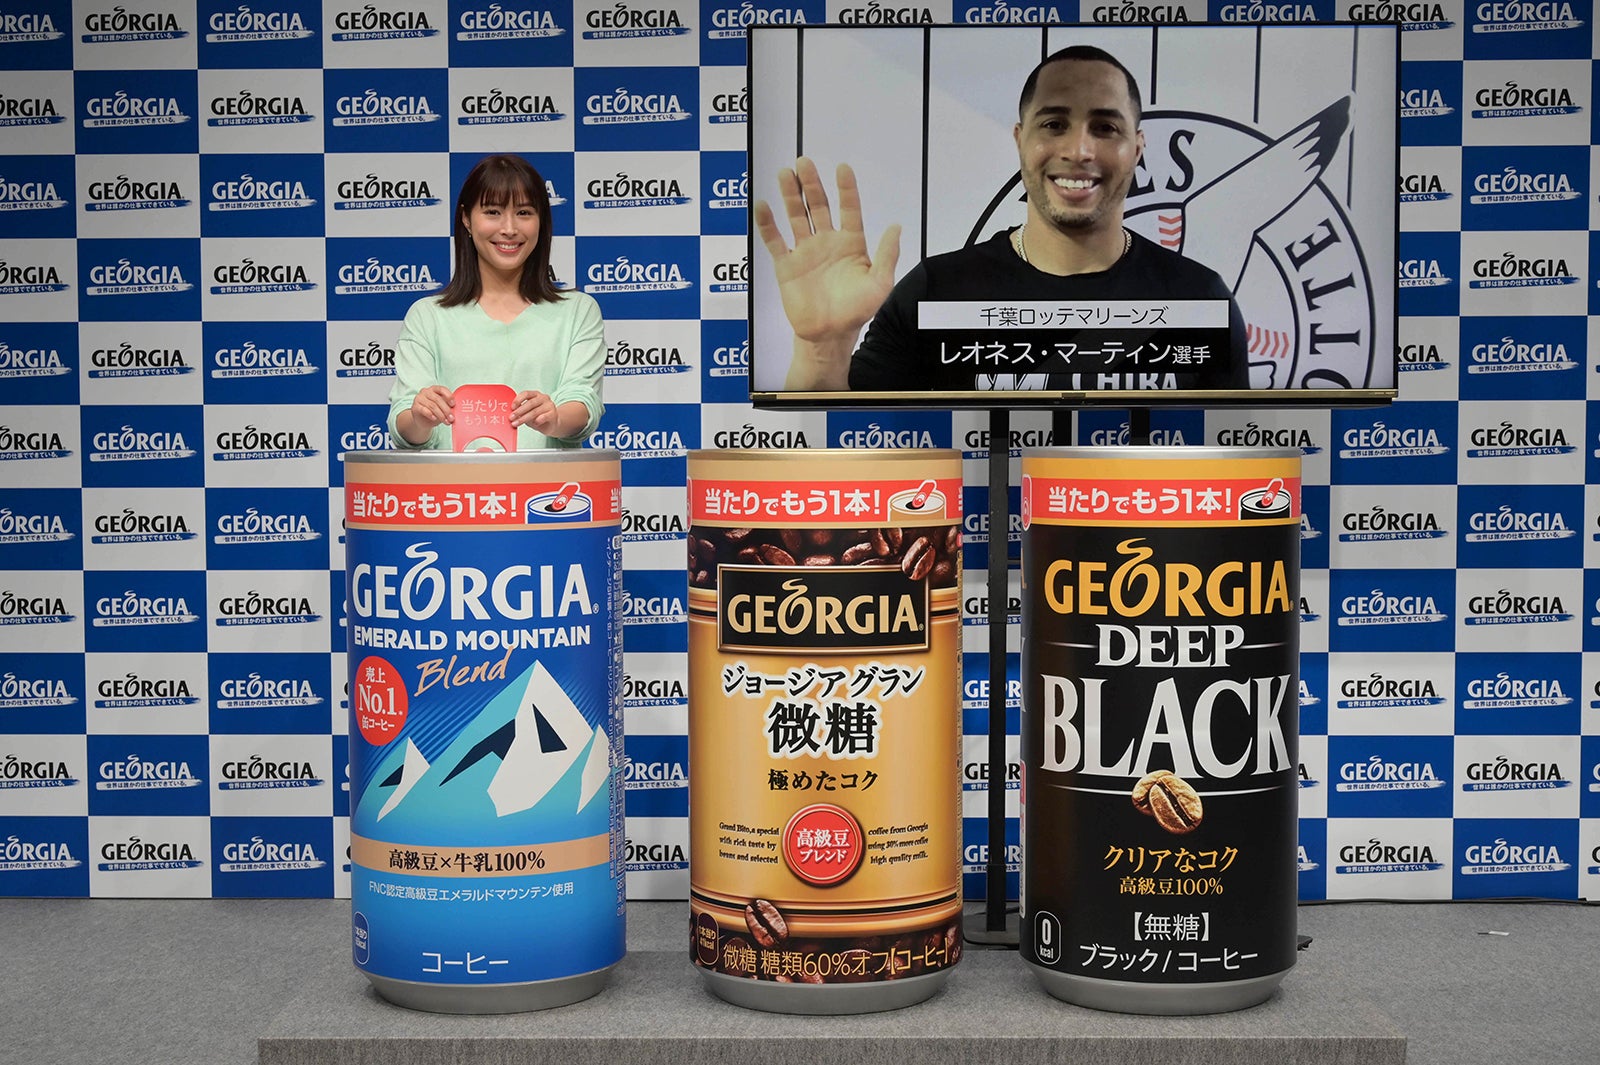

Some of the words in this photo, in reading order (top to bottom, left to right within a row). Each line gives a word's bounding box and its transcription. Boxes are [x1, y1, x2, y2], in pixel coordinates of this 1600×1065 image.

[84, 5, 178, 31] GEORGIA
[209, 4, 303, 30] GEORGIA
[334, 3, 428, 30] GEORGIA
[460, 2, 554, 29] GEORGIA
[585, 1, 680, 28] GEORGIA
[712, 0, 806, 25] GEORGIA
[838, 0, 933, 25] GEORGIA
[965, 0, 1060, 23] GEORGIA
[1092, 0, 1188, 23] GEORGIA
[1220, 0, 1316, 23] GEORGIA
[1348, 0, 1444, 22] GEORGIA
[1476, 0, 1573, 21] GEORGIA
[86, 89, 179, 116] GEORGIA
[210, 88, 304, 115] GEORGIA
[336, 88, 429, 114] GEORGIA
[461, 87, 555, 113] GEORGIA
[586, 86, 680, 113] GEORGIA
[1475, 79, 1571, 106] GEORGIA
[87, 173, 181, 200] GEORGIA
[211, 173, 305, 199] GEORGIA
[337, 172, 430, 198] GEORGIA
[587, 171, 681, 197] GEORGIA
[1474, 165, 1570, 192] GEORGIA
[89, 257, 182, 283] GEORGIA
[213, 257, 306, 283] GEORGIA
[338, 256, 431, 282] GEORGIA
[587, 255, 681, 281] GEORGIA
[1473, 250, 1569, 277] GEORGIA
[979, 305, 1169, 326] 千葉ロッテマリーンズ
[91, 341, 184, 367] GEORGIA
[214, 340, 308, 366] GEORGIA
[605, 339, 682, 365] EORGIA
[940, 341, 1211, 366] レオネス・マーティン選手
[1471, 335, 1567, 362] GEORGIA
[461, 399, 508, 413] 当たりで
[92, 424, 185, 450] GEORGIA
[216, 424, 309, 449] GEORGIA
[588, 423, 682, 449] GEORGIA
[713, 422, 807, 448] GEORGIA
[839, 422, 933, 448] GEORGIA
[1090, 421, 1185, 447] GEOGIA
[1216, 421, 1311, 447] GEORGIA
[1343, 420, 1438, 446] GEORGIA
[1470, 420, 1566, 446] GEORGIA
[353, 491, 518, 519] 当たりでもう1本!
[705, 488, 880, 516] 当たりでもう1本!
[1048, 486, 1231, 516] 当たりでもう1本!
[94, 507, 187, 532] GEORGIA
[217, 507, 310, 532] GEORGIA
[1342, 504, 1437, 530] GEORGIA
[1469, 504, 1565, 530] GEORGIA
[352, 541, 593, 622] GEORGIA
[1044, 538, 1290, 618] GEORGIA
[95, 589, 188, 615] GEORGIA
[218, 589, 311, 615] GEORGIA
[727, 578, 919, 636] GEORGIA
[1341, 588, 1436, 614] GEORGIA
[1468, 588, 1563, 614] GEORGIA
[354, 625, 448, 650] EMERALD
[456, 624, 591, 651] MOUNTAIN
[1095, 623, 1246, 668] DEEP
[97, 672, 189, 697] GEORGIA
[220, 672, 312, 697] GEORGIA
[365, 665, 386, 684] 売上
[413, 645, 514, 698] Blend
[1340, 671, 1435, 697] GEORGIA
[1467, 671, 1562, 697] GEORGIA
[361, 715, 395, 731] 缶コーヒー
[767, 701, 878, 754] 微糖
[1040, 673, 1292, 779] BLACK
[99, 753, 191, 779] GEORGIA
[221, 754, 313, 779] GEORGIA
[1340, 755, 1434, 780] GEORGIA
[1466, 755, 1561, 780] GEORGIA
[767, 768, 879, 792] 極めたコク
[796, 828, 850, 848] 高級豆
[890, 825, 906, 835] from
[100, 835, 192, 860] GEORGIA
[222, 835, 315, 860] GEORGIA
[800, 849, 847, 864] ブレンド
[1103, 845, 1239, 874] クリアなコク
[1339, 837, 1433, 863] GEORGIA
[1465, 837, 1560, 863] GEORGIA
[388, 848, 546, 874] 高級豆×牛乳100%
[369, 880, 574, 902] FNC認定高級豆エメラルドマウンテン使用
[1119, 876, 1224, 896] 高級豆100%
[1042, 917, 1051, 945] 0
[1133, 910, 1210, 942] 【無糖】
[422, 951, 509, 975] コーヒー
[723, 944, 757, 974] 微糖
[1080, 944, 1258, 974] ブラック/コーヒー
